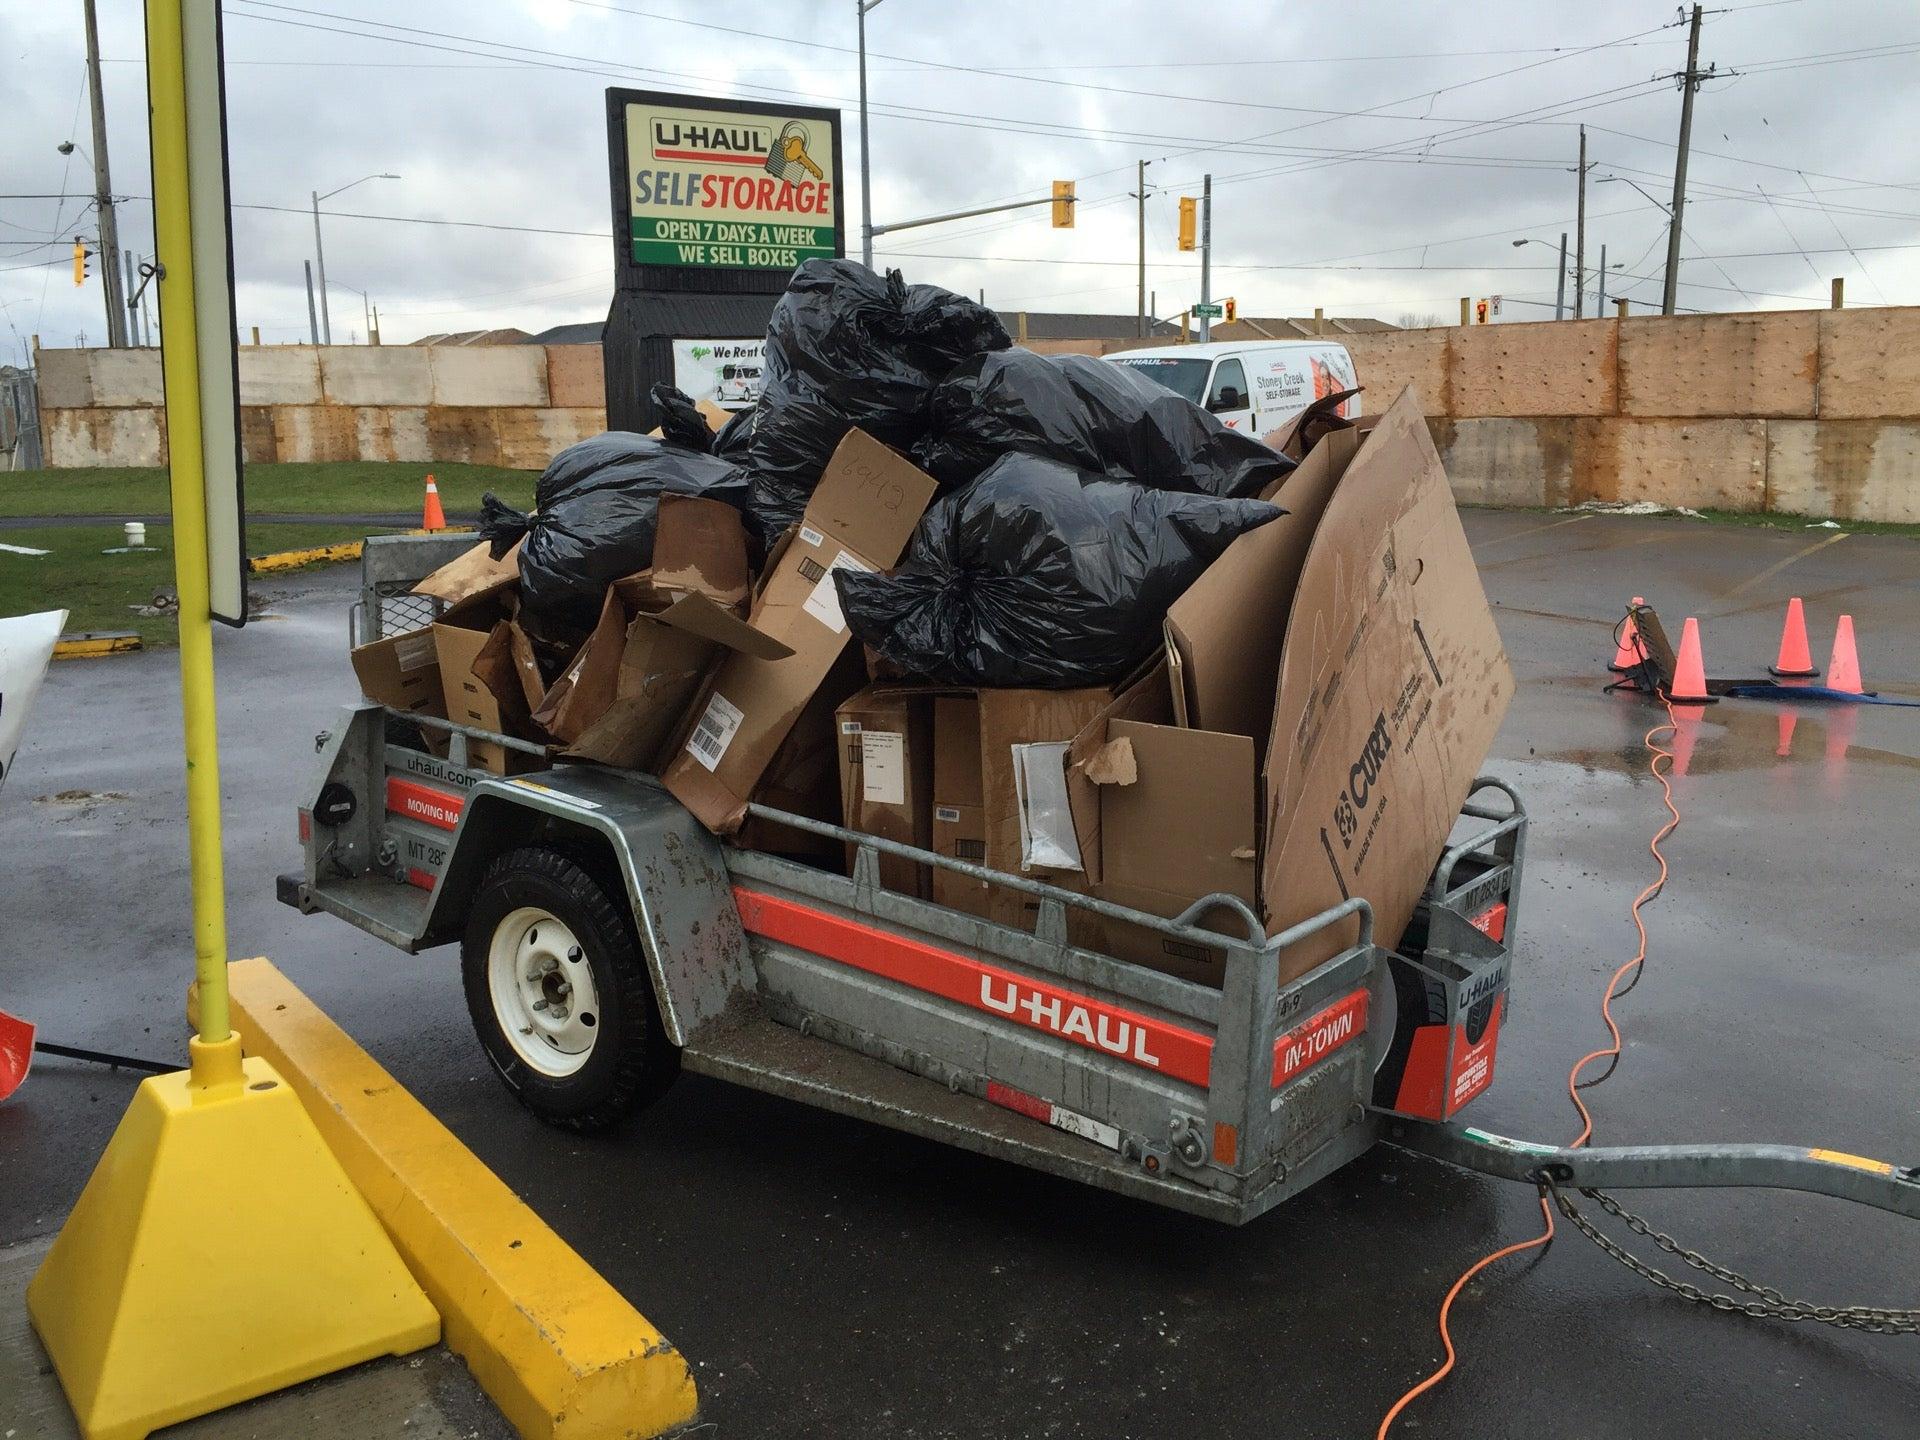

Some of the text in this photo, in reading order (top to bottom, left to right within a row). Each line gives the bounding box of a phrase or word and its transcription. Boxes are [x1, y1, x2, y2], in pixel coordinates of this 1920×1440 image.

[655, 123, 768, 153] U-HAUL
[656, 220, 816, 246] OPEN 7 DAYS A WEEK
[678, 245, 798, 267] WE SELL BOXES
[713, 346, 731, 358] We
[733, 346, 758, 358] Rent
[1256, 372, 1305, 389] Stoney Creek
[1265, 387, 1302, 401] SELF-STORAGE
[407, 758, 478, 788] uhaul.com
[1350, 711, 1392, 809] CURT
[407, 798, 443, 820] MOVING
[408, 840, 425, 861] MT
[1459, 967, 1504, 1010] U-HAUL
[980, 974, 1160, 1067] U-HAUL
[1284, 1010, 1353, 1074] IN-TOWN
